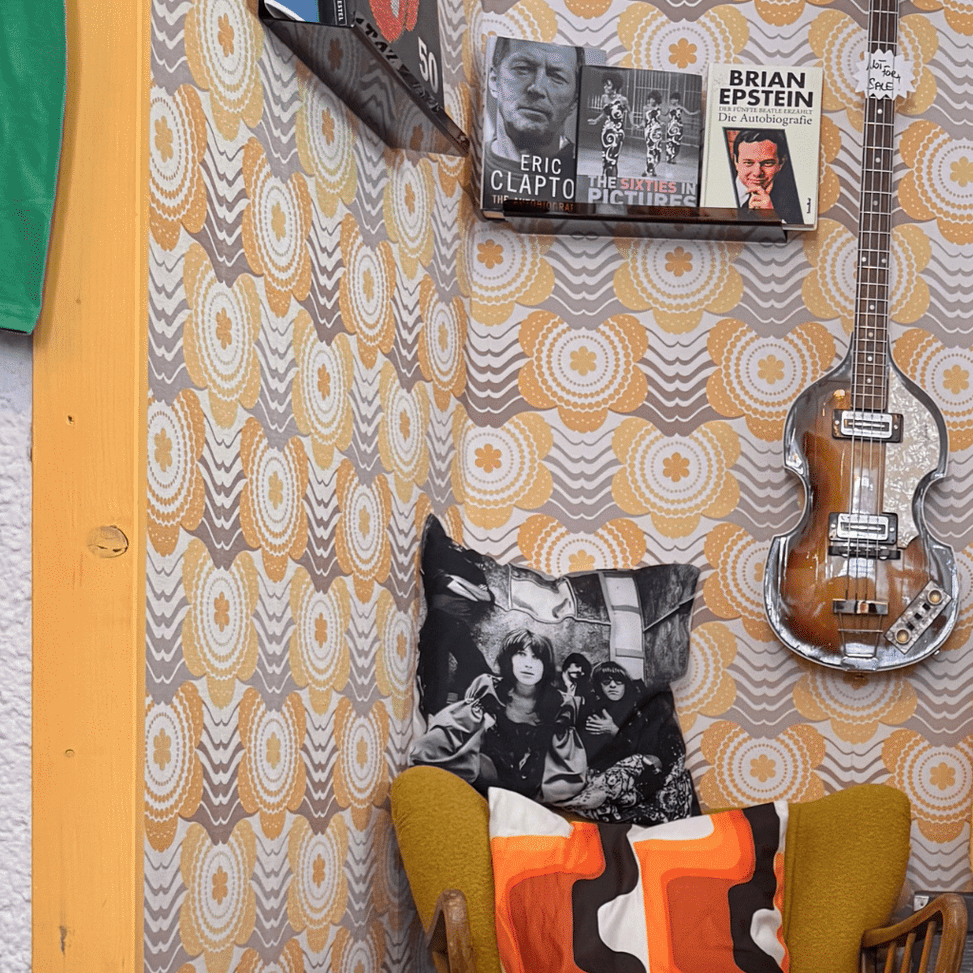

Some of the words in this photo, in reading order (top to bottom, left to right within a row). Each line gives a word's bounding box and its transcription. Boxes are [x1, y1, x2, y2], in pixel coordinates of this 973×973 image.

[417, 36, 439, 94] 50
[729, 69, 806, 89] BRIAN
[719, 88, 814, 108] EPSTEIN
[718, 112, 737, 122] Die
[739, 113, 813, 127] Autobiografie
[520, 154, 562, 175] ERIC
[490, 169, 575, 200] CLAPTO
[588, 175, 617, 189] THE
[620, 178, 677, 193] SIXTIES
[681, 182, 696, 195] IN
[588, 187, 697, 207] PICTURES
